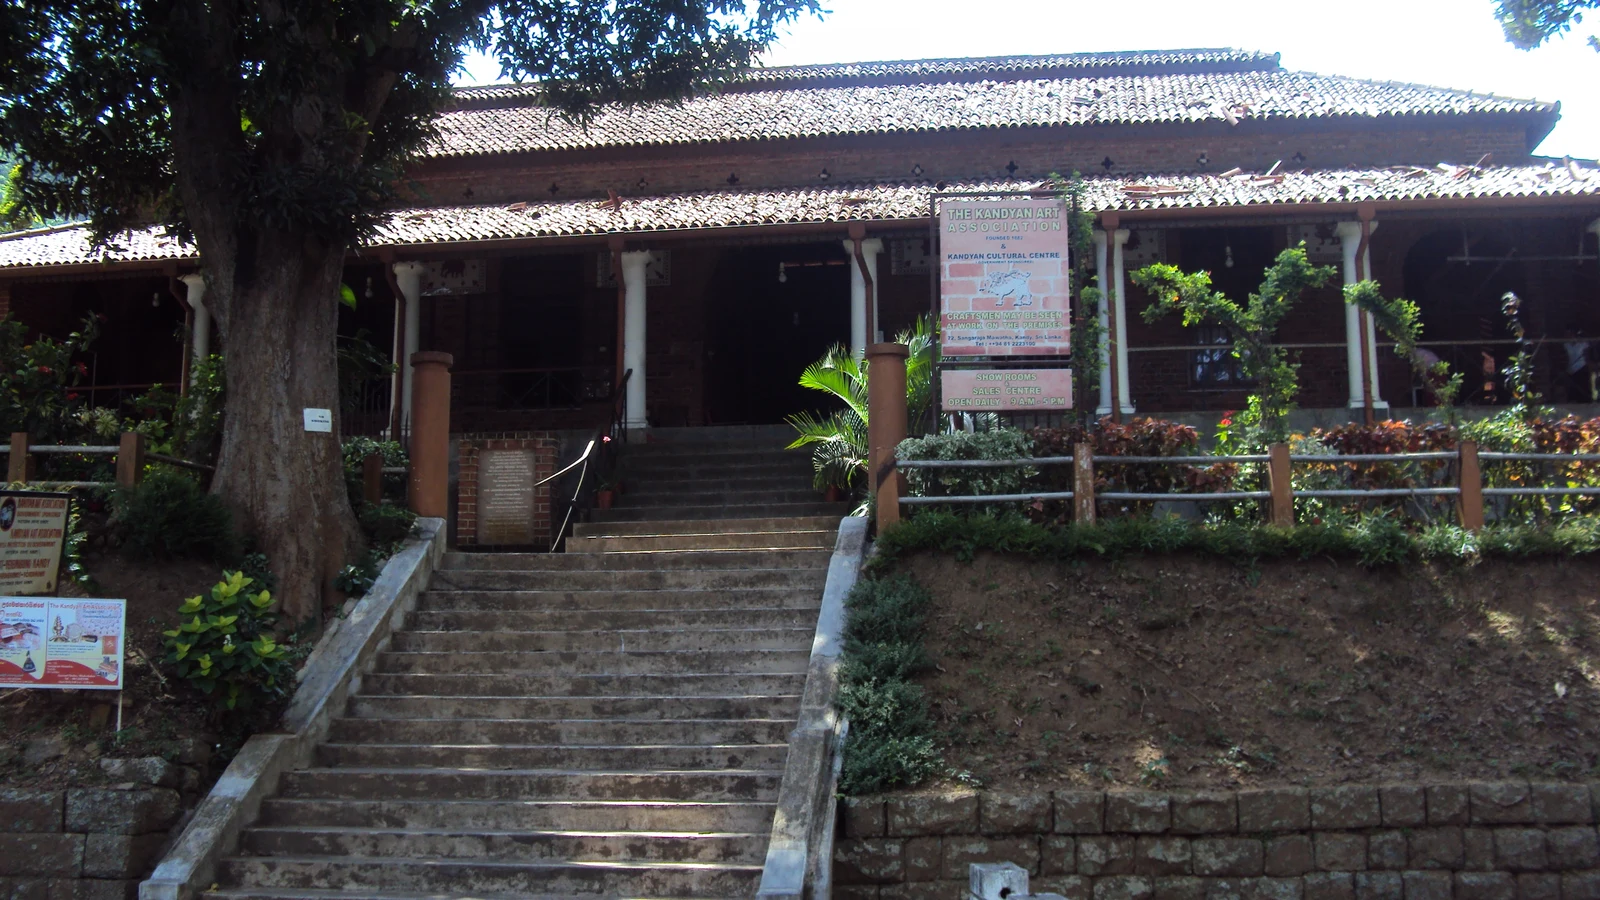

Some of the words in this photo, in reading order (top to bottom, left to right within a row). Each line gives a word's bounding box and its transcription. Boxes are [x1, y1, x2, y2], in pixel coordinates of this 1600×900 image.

[947, 207, 972, 220] THE
[975, 207, 1032, 219] KANDYAN
[1036, 207, 1060, 219] ART
[947, 222, 1061, 233] ASSOCIATION
[947, 312, 1001, 320] CRAFTSMEN
[1003, 312, 1022, 320] MAY
[1025, 311, 1037, 319] BE
[1039, 311, 1063, 319] SEEN
[946, 322, 956, 330] AT
[958, 322, 983, 330] WORK
[1023, 321, 1063, 329] PREMISES
[1005, 387, 1041, 395] CENTRE
[948, 398, 972, 406] OPEN
[975, 398, 1000, 406] DAILY
[1010, 397, 1016, 405] 9
[1043, 397, 1048, 405] 5
